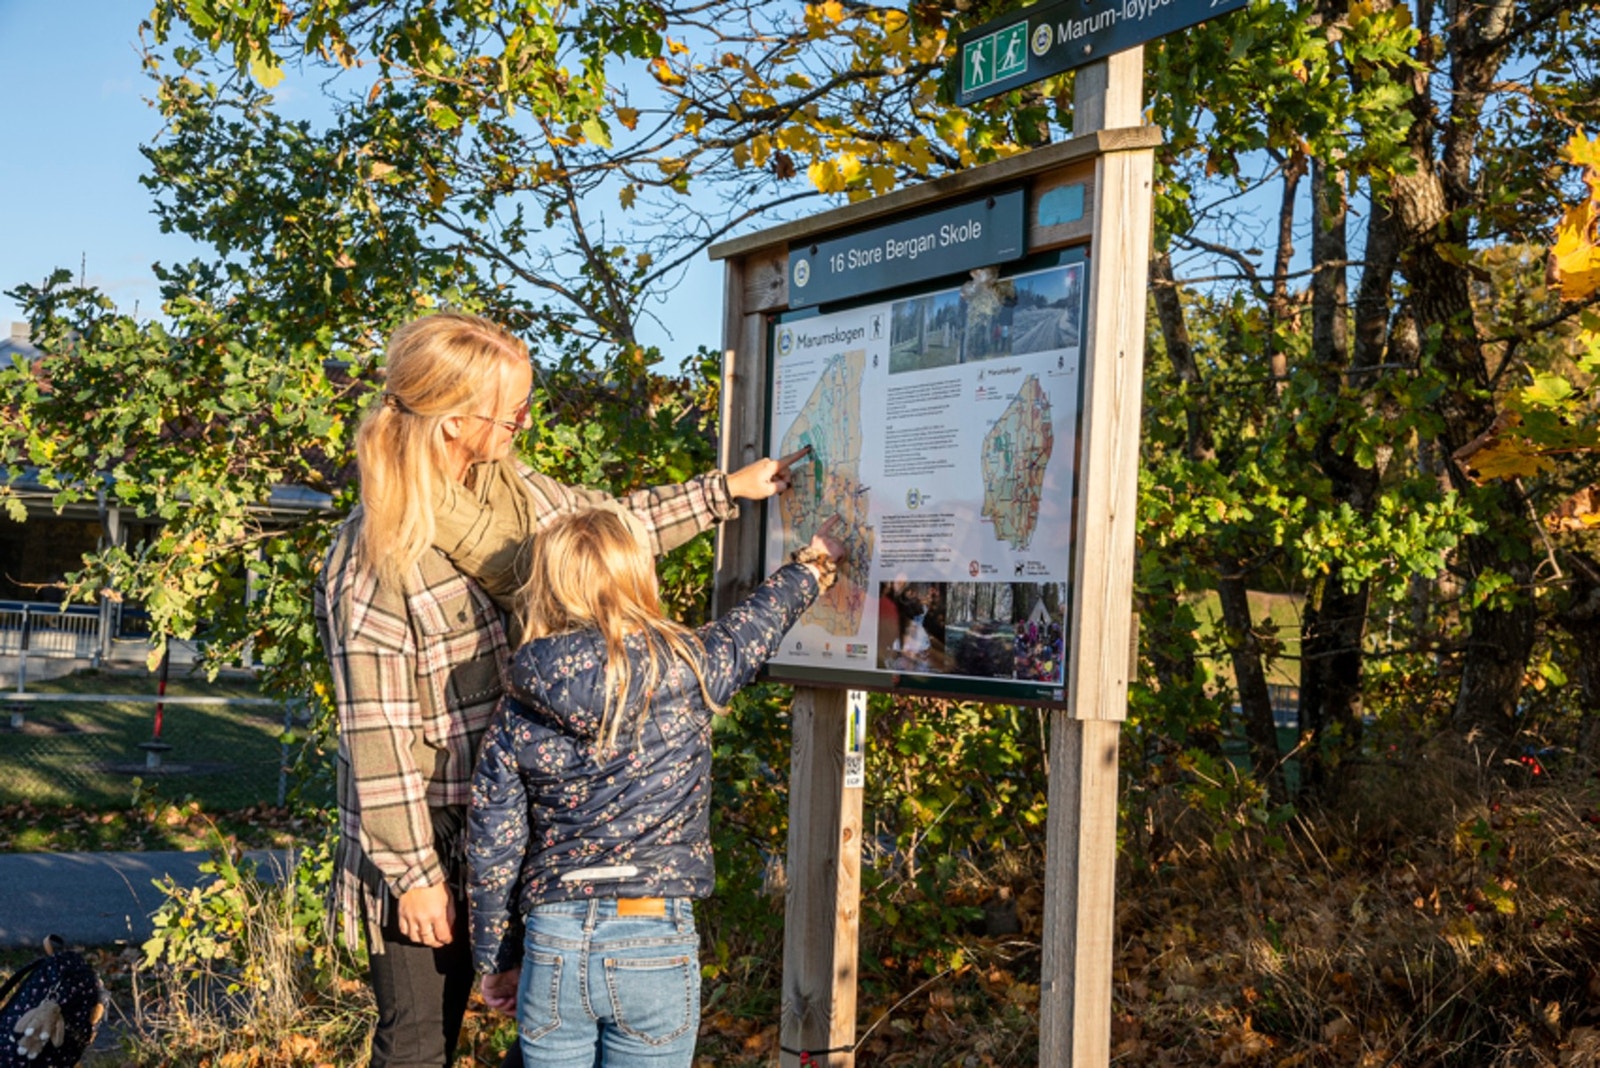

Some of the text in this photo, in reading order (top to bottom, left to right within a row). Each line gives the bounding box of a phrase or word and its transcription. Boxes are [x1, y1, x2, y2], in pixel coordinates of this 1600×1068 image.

[1057, 0, 1176, 44] Marum-løyp
[829, 219, 982, 274] 16 Store Bergan Skole
[796, 326, 865, 349] Marumskogen
